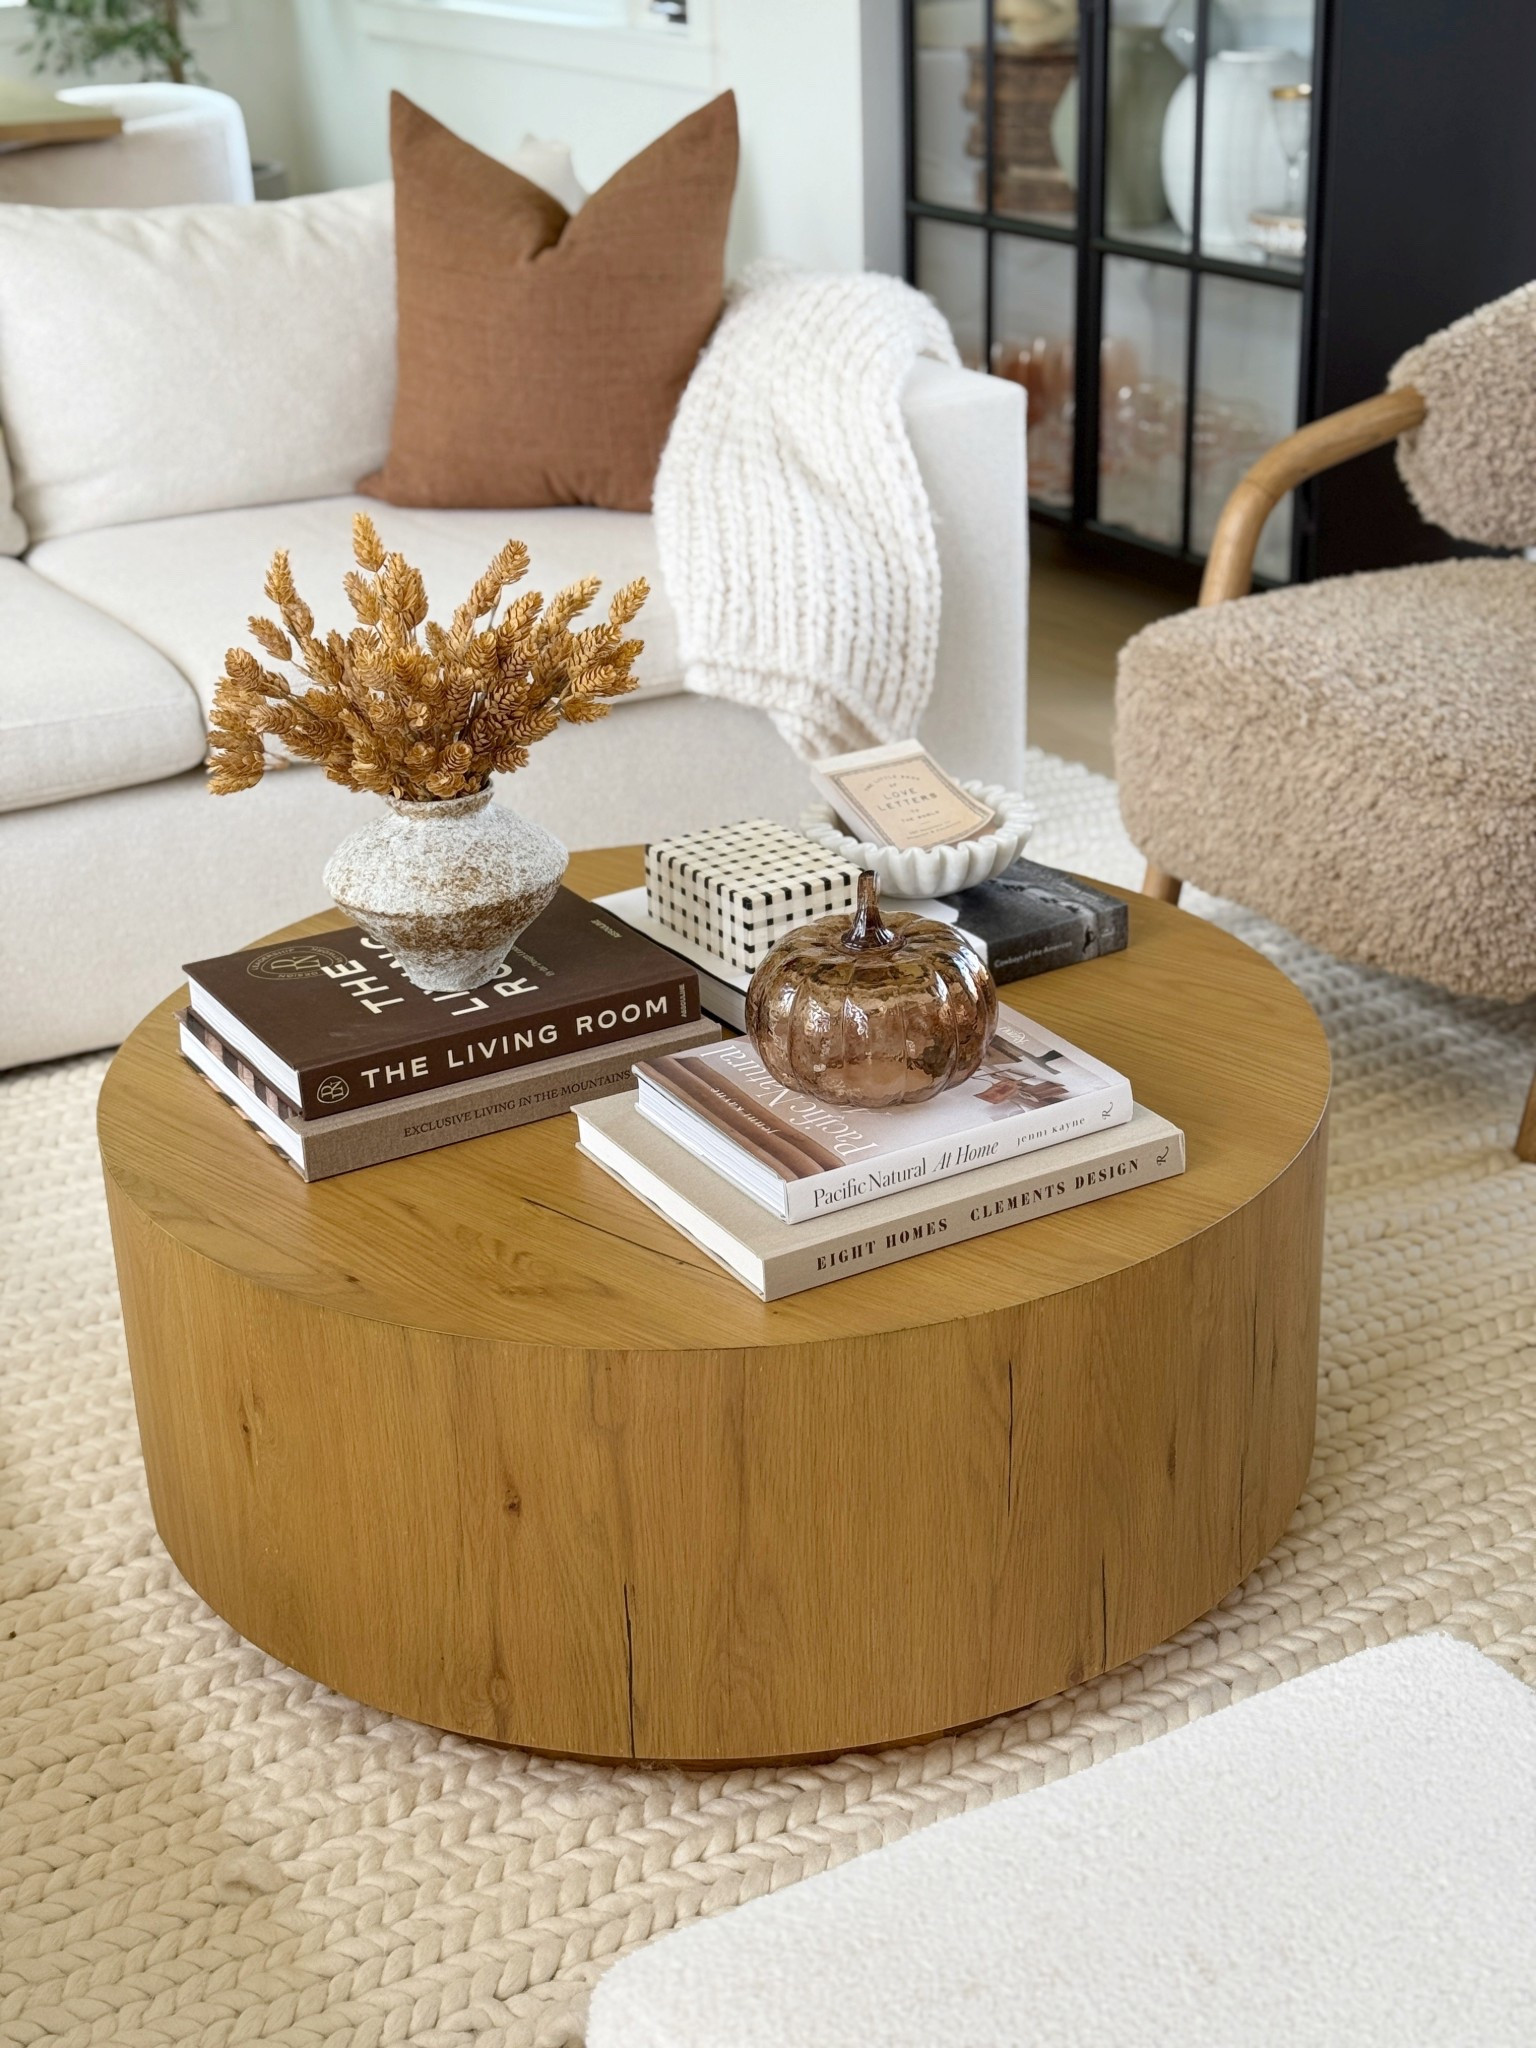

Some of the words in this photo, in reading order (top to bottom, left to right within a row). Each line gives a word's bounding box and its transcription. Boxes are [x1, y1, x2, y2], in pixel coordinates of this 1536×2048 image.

[877, 792, 938, 812] LETTERS
[883, 787, 918, 801] LOVE
[1032, 949, 1042, 957] the
[320, 959, 405, 1014] THE
[361, 1056, 429, 1089] THE
[447, 1024, 558, 1069] LIVING
[575, 996, 668, 1035] ROOM
[403, 1111, 472, 1138] EXCLUSIVE
[474, 1099, 515, 1119] LIVING
[518, 1096, 532, 1107] IN
[534, 1088, 559, 1103] THE
[561, 1070, 631, 1096] MOUNTAINS
[700, 1045, 804, 1109] Natural
[789, 1101, 879, 1157] Pacific
[813, 1179, 867, 1207] Pacific
[869, 1157, 926, 1191] Natural
[932, 1151, 952, 1172] At
[956, 1140, 999, 1165] Home
[970, 1181, 1066, 1222] CLEMENTS
[1075, 1158, 1140, 1190] DESIGN
[816, 1240, 876, 1271] EIGHT
[885, 1217, 948, 1249] HOMES
